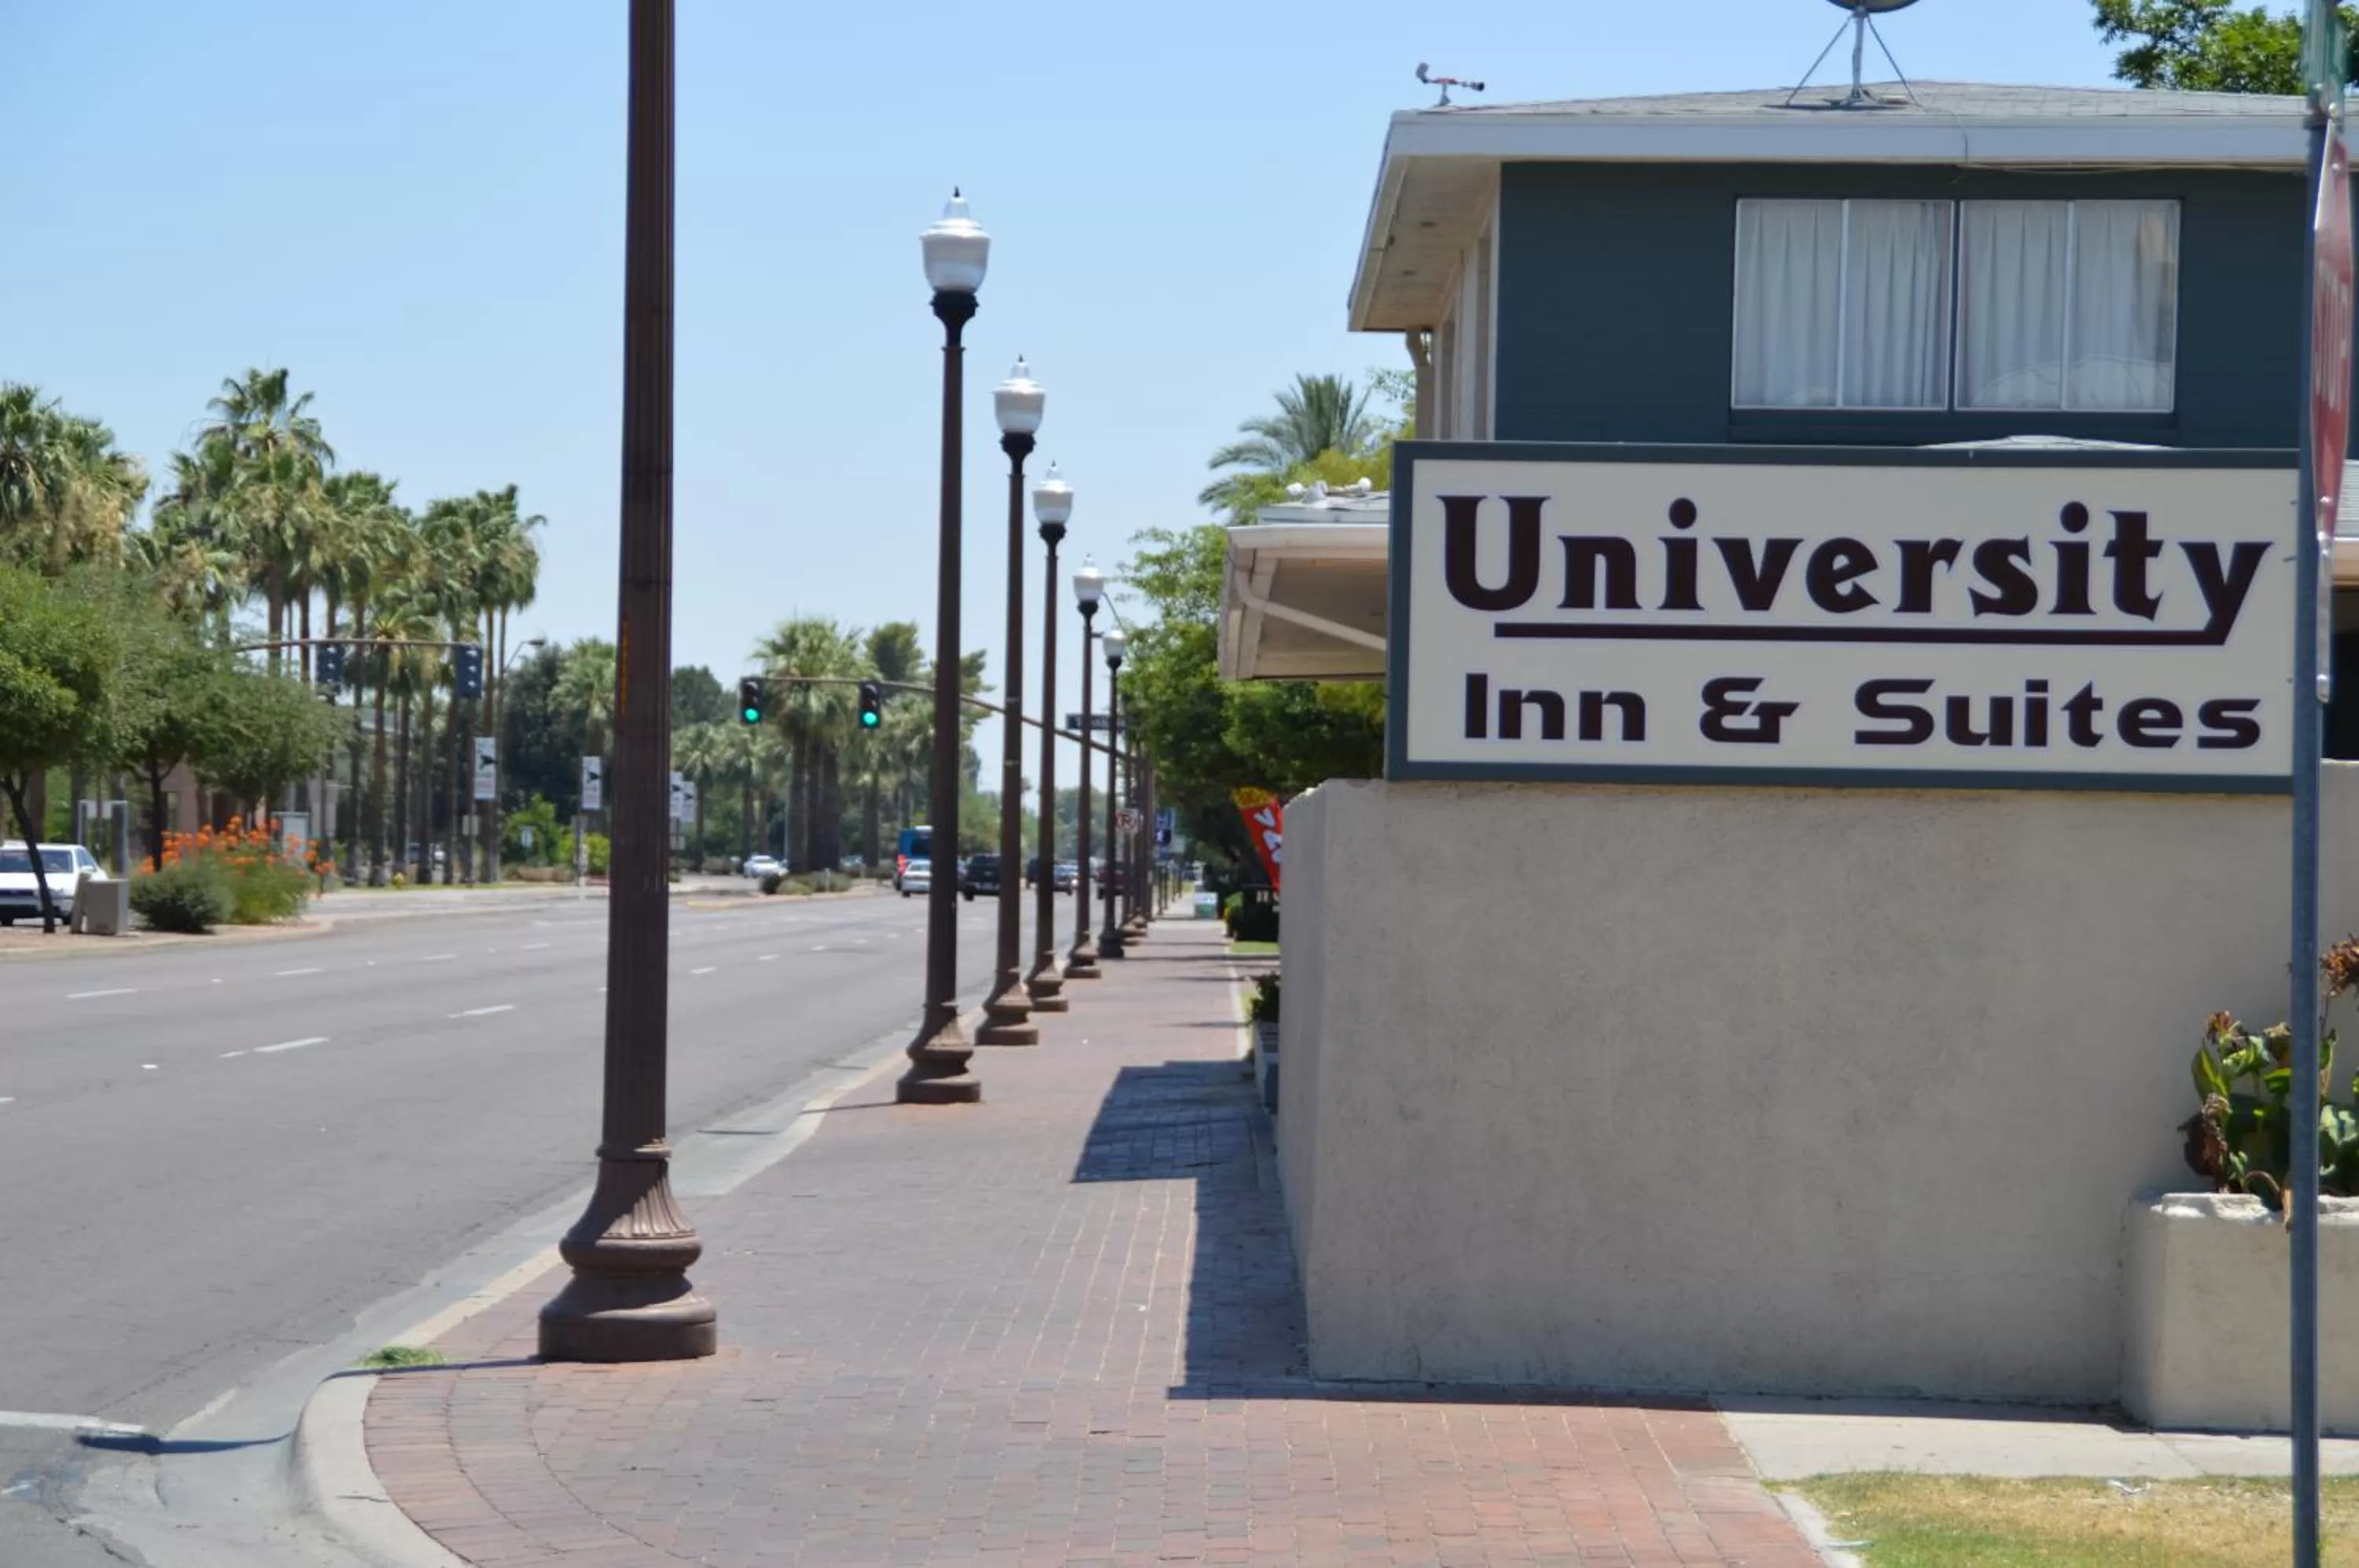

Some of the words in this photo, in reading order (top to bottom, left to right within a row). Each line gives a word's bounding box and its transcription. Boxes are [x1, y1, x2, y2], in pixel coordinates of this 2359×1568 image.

[1436, 495, 2274, 646] University
[1464, 672, 1647, 742] Inn
[1698, 676, 1801, 745] &
[1853, 678, 2261, 750] Suites
